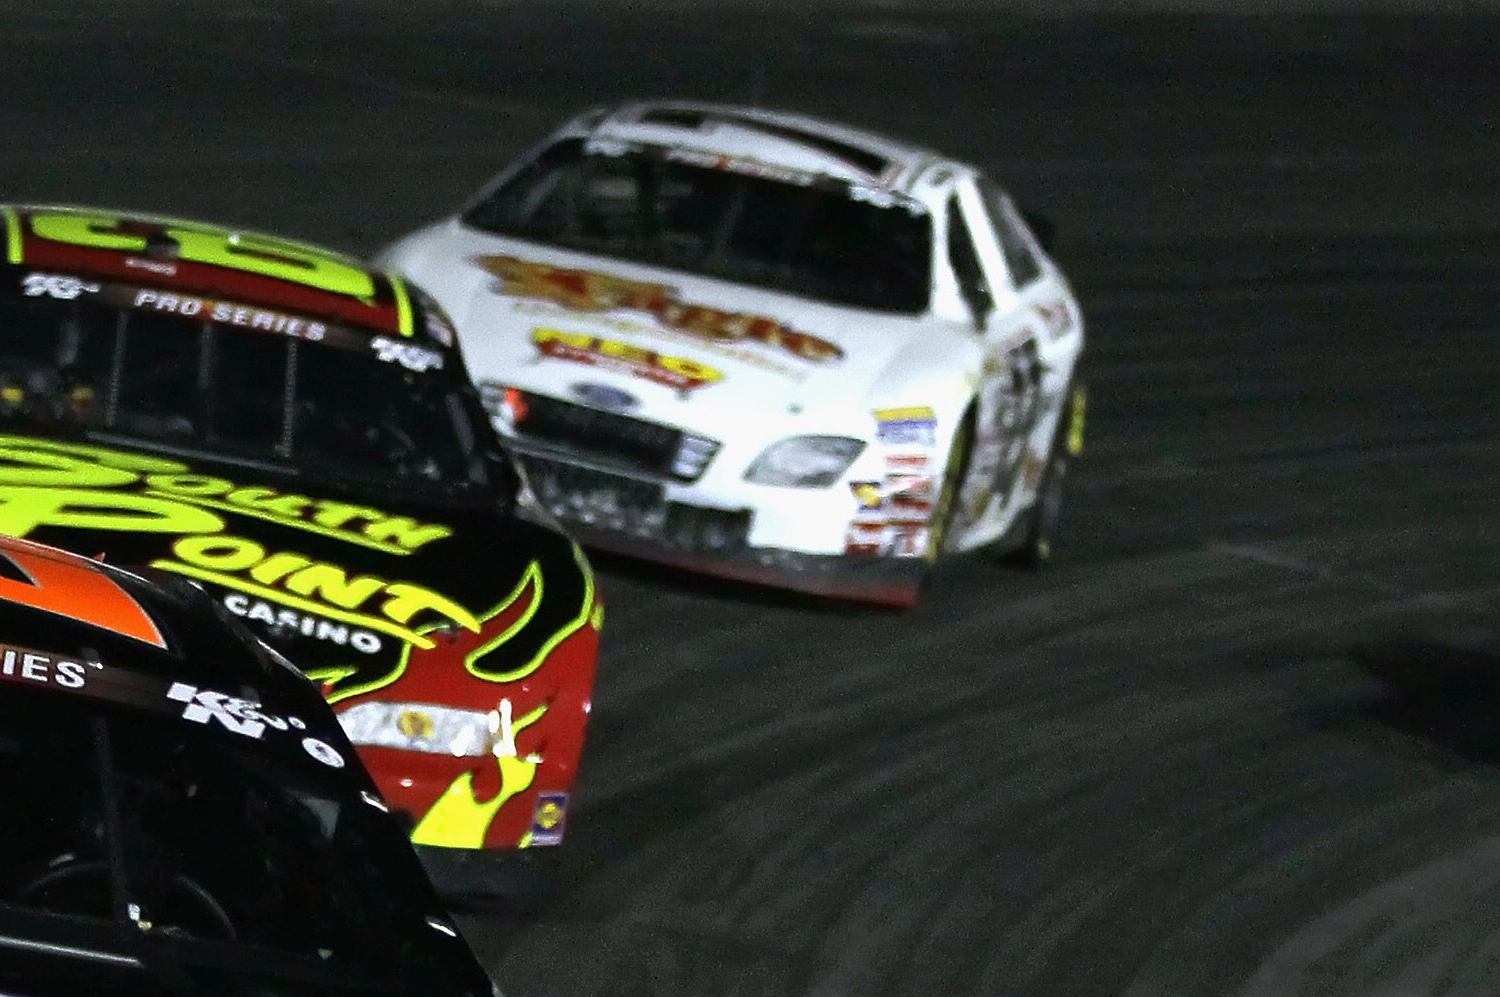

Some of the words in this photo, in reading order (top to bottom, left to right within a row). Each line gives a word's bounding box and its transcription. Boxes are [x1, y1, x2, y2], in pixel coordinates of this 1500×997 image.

[134, 291, 200, 316] PRO
[211, 302, 326, 342] SERIES
[224, 594, 382, 655] CASINO
